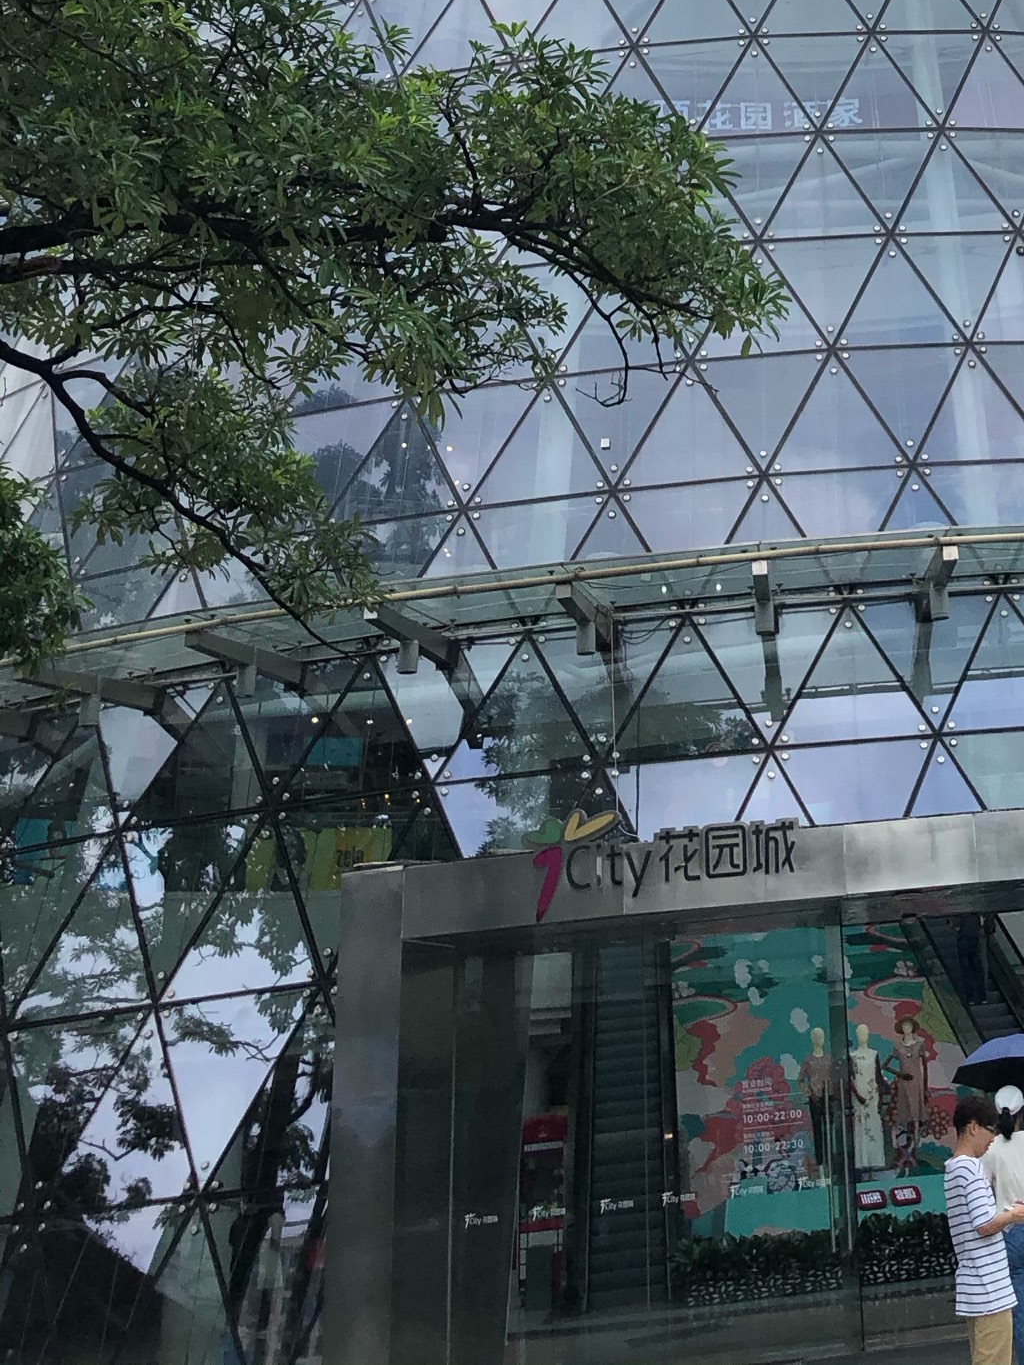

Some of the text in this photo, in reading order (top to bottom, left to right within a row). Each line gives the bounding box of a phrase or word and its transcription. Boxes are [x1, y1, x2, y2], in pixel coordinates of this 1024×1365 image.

[656, 821, 796, 883] 花园城
[743, 1109, 802, 1124] 10:00-22:00
